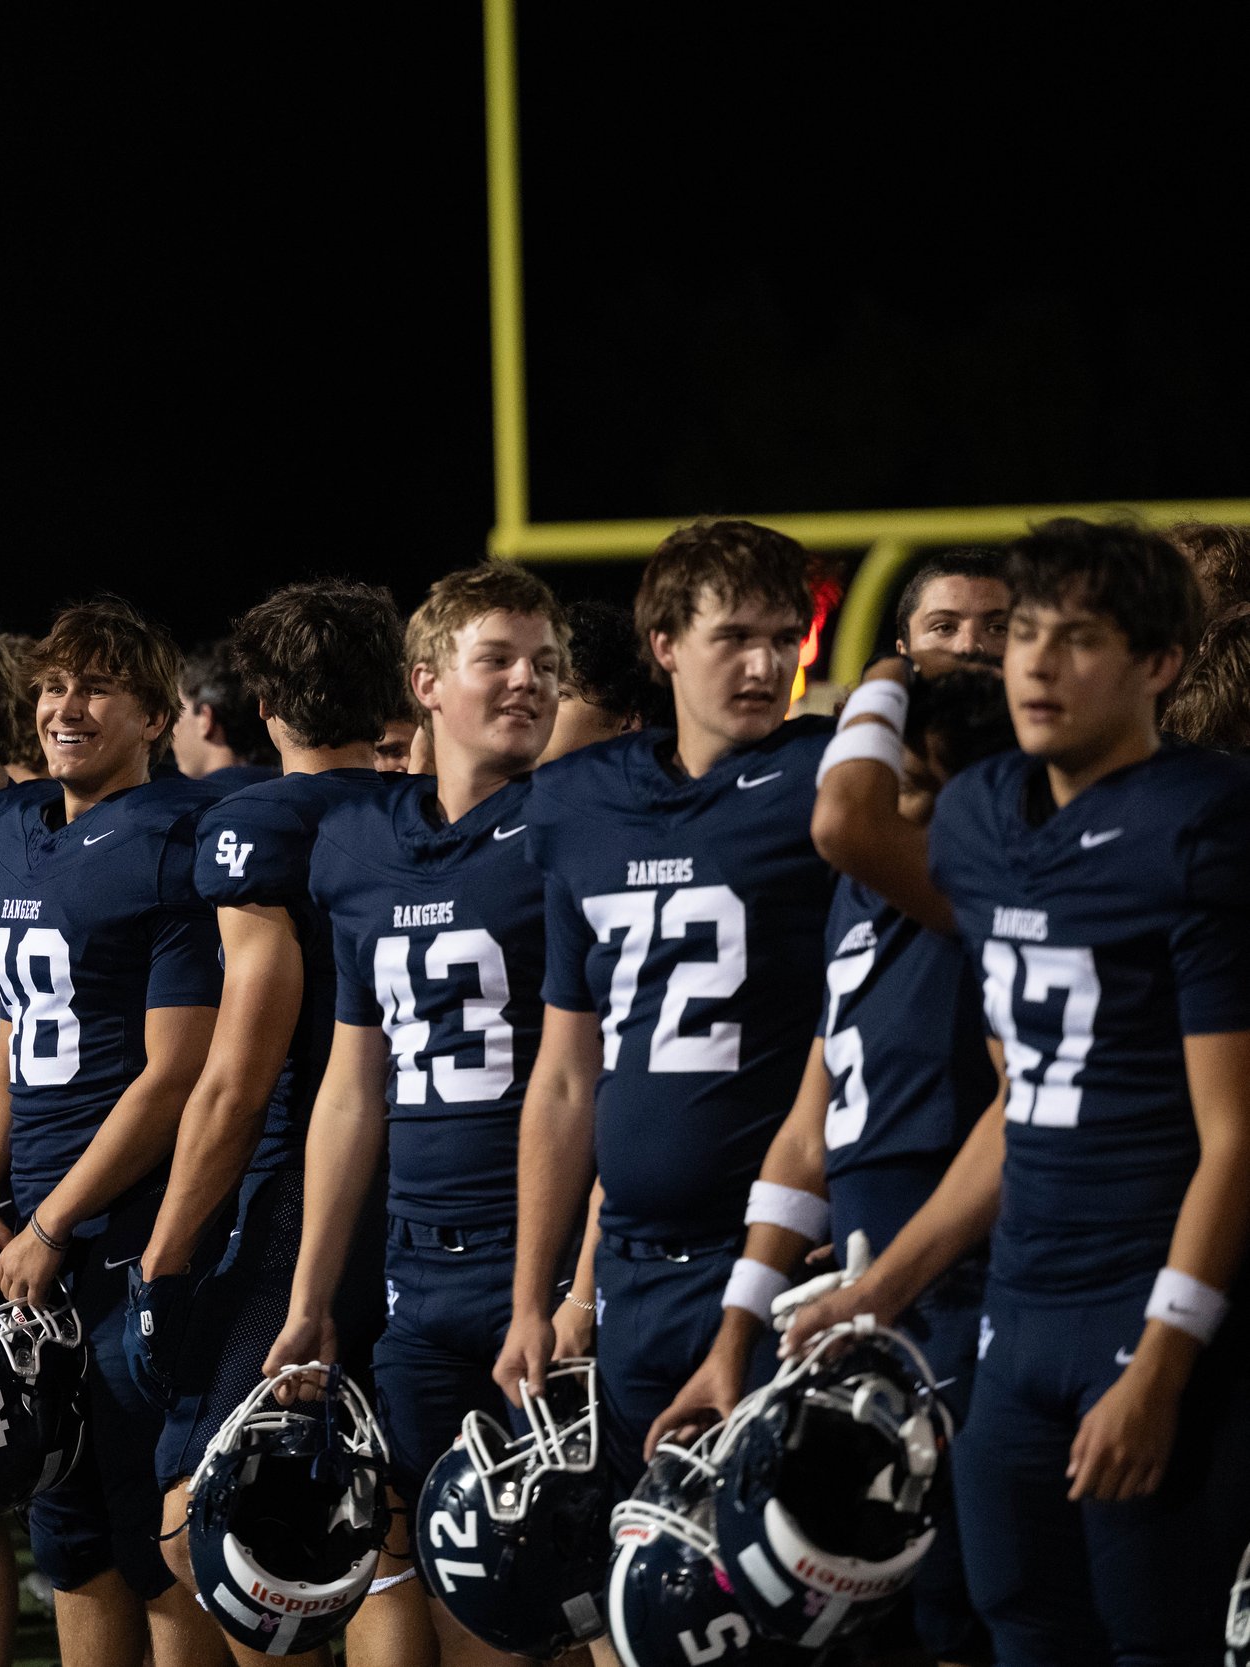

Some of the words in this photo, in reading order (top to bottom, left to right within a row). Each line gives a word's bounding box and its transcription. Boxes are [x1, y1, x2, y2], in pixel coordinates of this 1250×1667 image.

[216, 831, 253, 877] SV
[627, 858, 694, 885] RANGERS
[1, 899, 42, 920] RANGERS
[393, 901, 454, 928] RANGERS
[582, 885, 748, 1073] 72
[374, 928, 514, 1105] 43
[429, 1510, 487, 1593] 72
[250, 1579, 349, 1614] Riddell
[678, 1611, 750, 1667] 5
